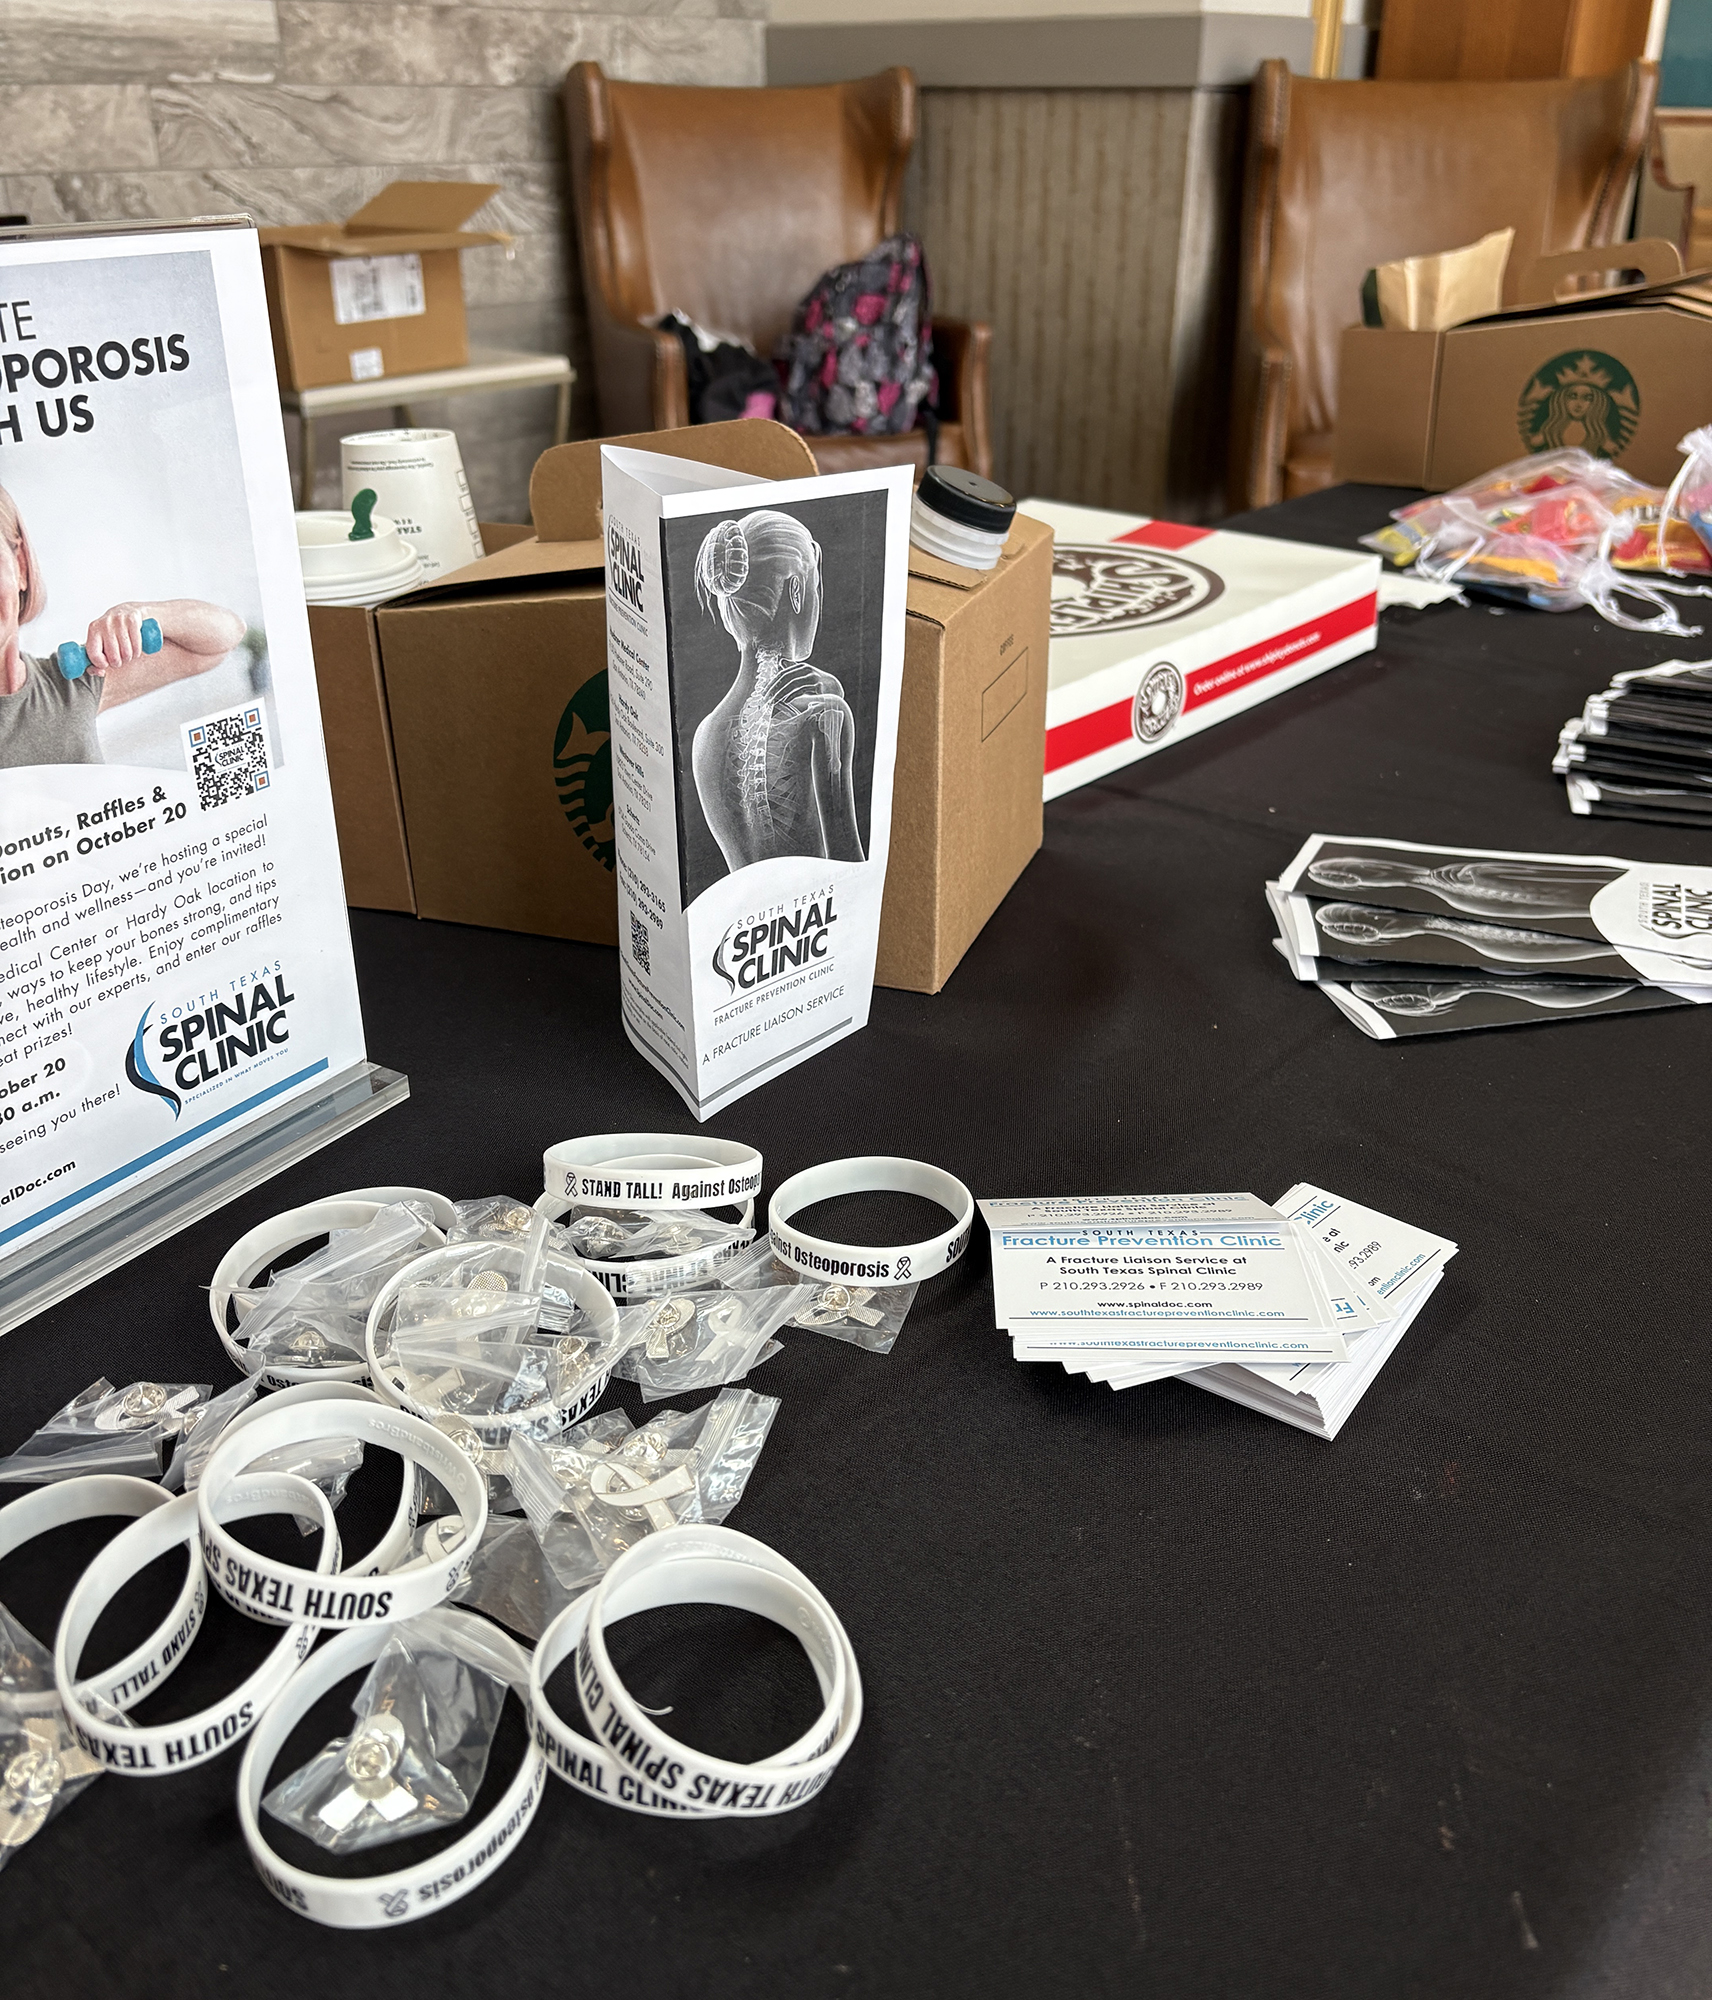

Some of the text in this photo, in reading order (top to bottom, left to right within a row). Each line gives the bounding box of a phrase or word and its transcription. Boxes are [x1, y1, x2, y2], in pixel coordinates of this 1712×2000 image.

[0, 333, 190, 393] POROSIS
[36, 394, 95, 437] US
[611, 527, 644, 583] SPINAL
[613, 562, 643, 613] CLINIC
[0, 786, 167, 859] onuts, Raffles &
[43, 850, 69, 868] on
[76, 817, 156, 855] October
[162, 802, 187, 824] 20
[0, 892, 78, 930] teoporosis
[82, 880, 114, 898] Day,
[161, 842, 208, 867] hosting
[212, 837, 220, 847] a
[225, 813, 268, 843] special
[42, 911, 70, 935] and
[221, 834, 266, 862] invited!
[50, 934, 97, 960] Center
[105, 925, 119, 939] or
[126, 904, 167, 930] Hardy
[174, 888, 203, 909] Oak
[207, 868, 256, 895] location
[263, 862, 274, 873] to
[732, 896, 838, 962] SPINAL
[737, 884, 834, 930] SOUTH TEXAS
[1651, 884, 1682, 929] SPINAL
[1685, 888, 1712, 930] CLINIC
[7, 878, 277, 1000] ways to keep your bones strong, and tips
[26, 983, 79, 1013] healthy
[86, 956, 142, 987] lifestyle.
[149, 937, 184, 960] Enjoy
[190, 896, 279, 941] complimentary
[738, 928, 828, 989] CLINIC
[33, 1008, 64, 1030] with
[69, 998, 92, 1014] our
[98, 972, 151, 1001] experts,
[156, 954, 181, 975] and
[186, 942, 217, 962] enter
[221, 931, 241, 946] our
[245, 912, 282, 936] raffles
[160, 960, 281, 1024] SOUTH TEXAS
[714, 963, 834, 1026] FRACTURE PREVENTION CLINIC
[24, 1022, 73, 1059] prizes!
[159, 974, 295, 1062] SPINAL
[702, 985, 845, 1065] A FRACTURE LIAISON SERVICE
[43, 1058, 66, 1078] 20
[175, 1009, 290, 1090] CLINIC
[22, 1088, 61, 1112] a.m.
[185, 1081, 224, 1105] SPECIALIZED
[234, 1067, 252, 1079] WHAT
[253, 1055, 274, 1068] MOVES
[0, 1083, 121, 1154] seeing you there!
[0, 1160, 76, 1207] alDoc.com
[582, 1178, 725, 1201] STAND TALL! Against
[1003, 1235, 1282, 1247] Fracture Prevention Clinic
[1046, 1256, 1247, 1264] A Fracture Liaison Service at
[1329, 1227, 1341, 1238] at
[1348, 1240, 1382, 1270] 93.2989
[794, 1246, 890, 1278] Osteoporosis
[1040, 1282, 1263, 1291] P 210.293.2926 F 210.293.2989
[1060, 1267, 1237, 1276] South Texas Spinal Clinic
[1030, 1309, 1285, 1318] www.southtexasfracturepreventionclinic.com
[1097, 1300, 1213, 1309] www.spinaldoc.com
[225, 1557, 295, 1613] TEXAS
[303, 1588, 393, 1621] SOUTH
[111, 1609, 196, 1704] STAND TALL!
[75, 1701, 253, 1768] SOUTH TEXAS
[536, 1718, 608, 1794] SPINAL
[601, 1702, 684, 1789] SPINAL
[687, 1774, 775, 1810] TEXAS
[418, 1789, 534, 1904] Osteoporosis
